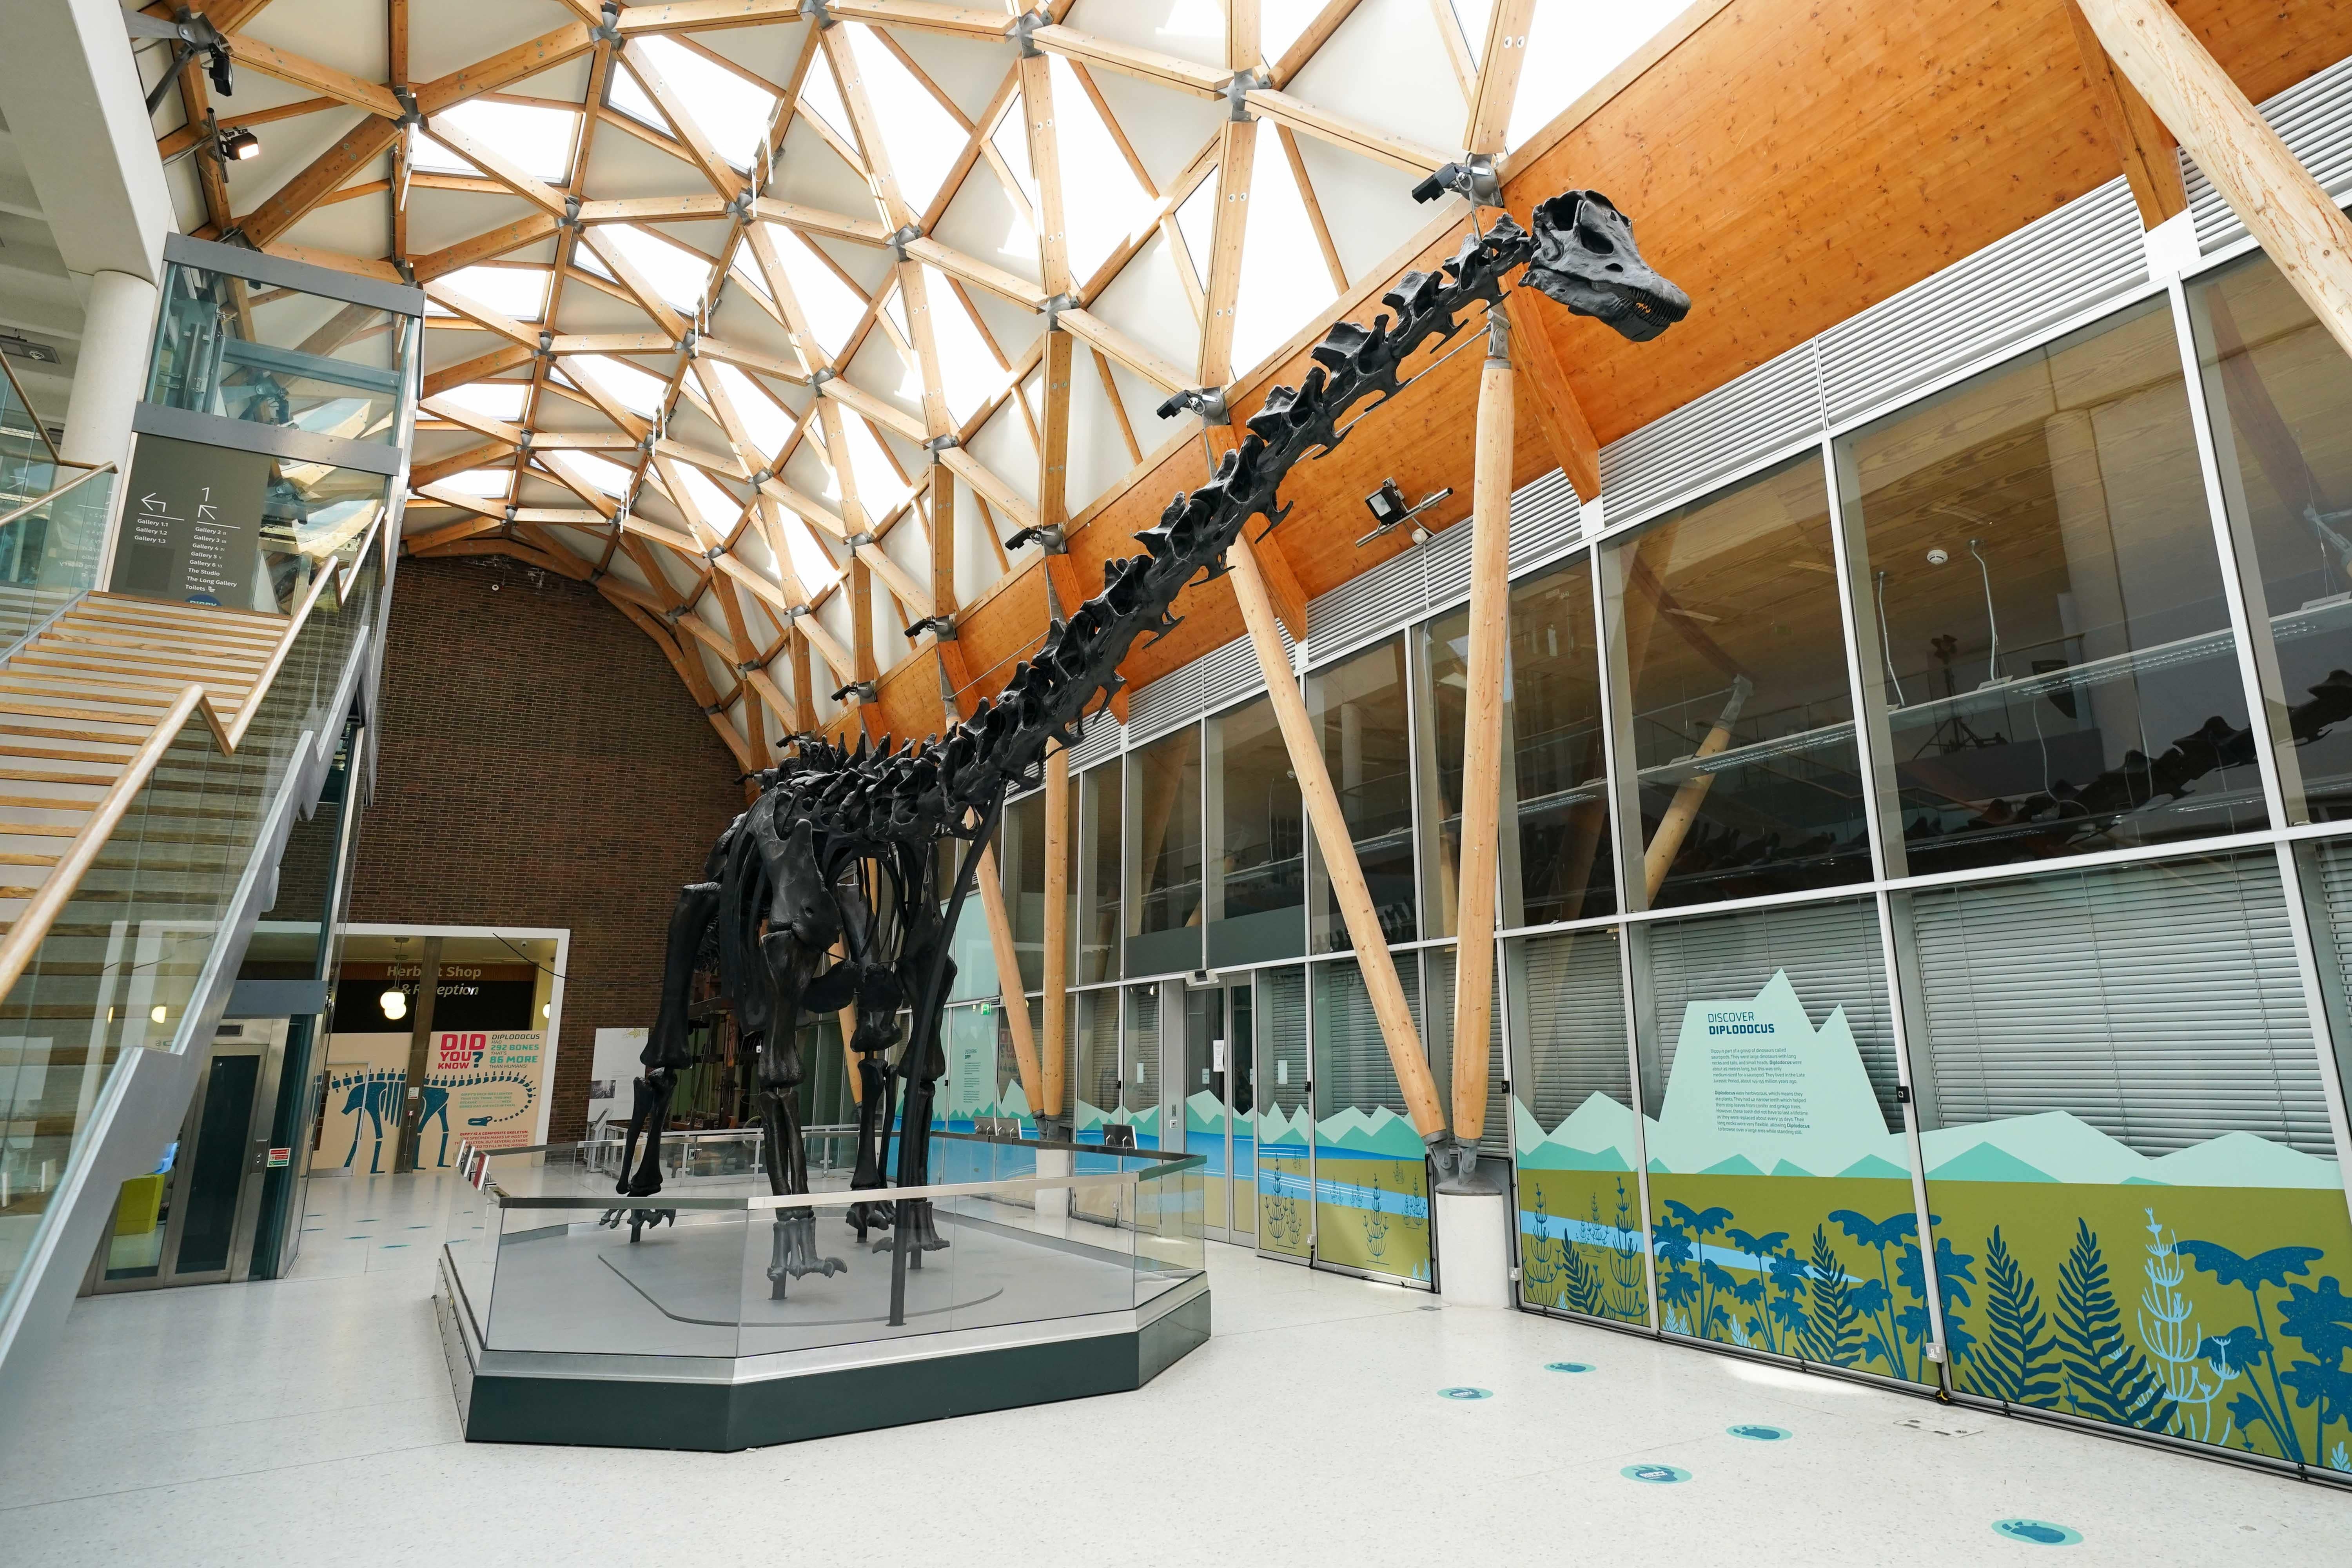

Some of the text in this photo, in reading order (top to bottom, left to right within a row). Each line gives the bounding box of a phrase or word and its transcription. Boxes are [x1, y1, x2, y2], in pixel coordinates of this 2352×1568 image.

[202, 487, 209, 501] 1
[387, 966, 481, 980] Herbt Shop
[402, 983, 479, 998] & Reption
[1708, 1012, 1754, 1022] DISCOVER
[1709, 1024, 1774, 1034] DIPLODOCUS
[441, 1034, 486, 1050] DID
[440, 1051, 471, 1061] YOU
